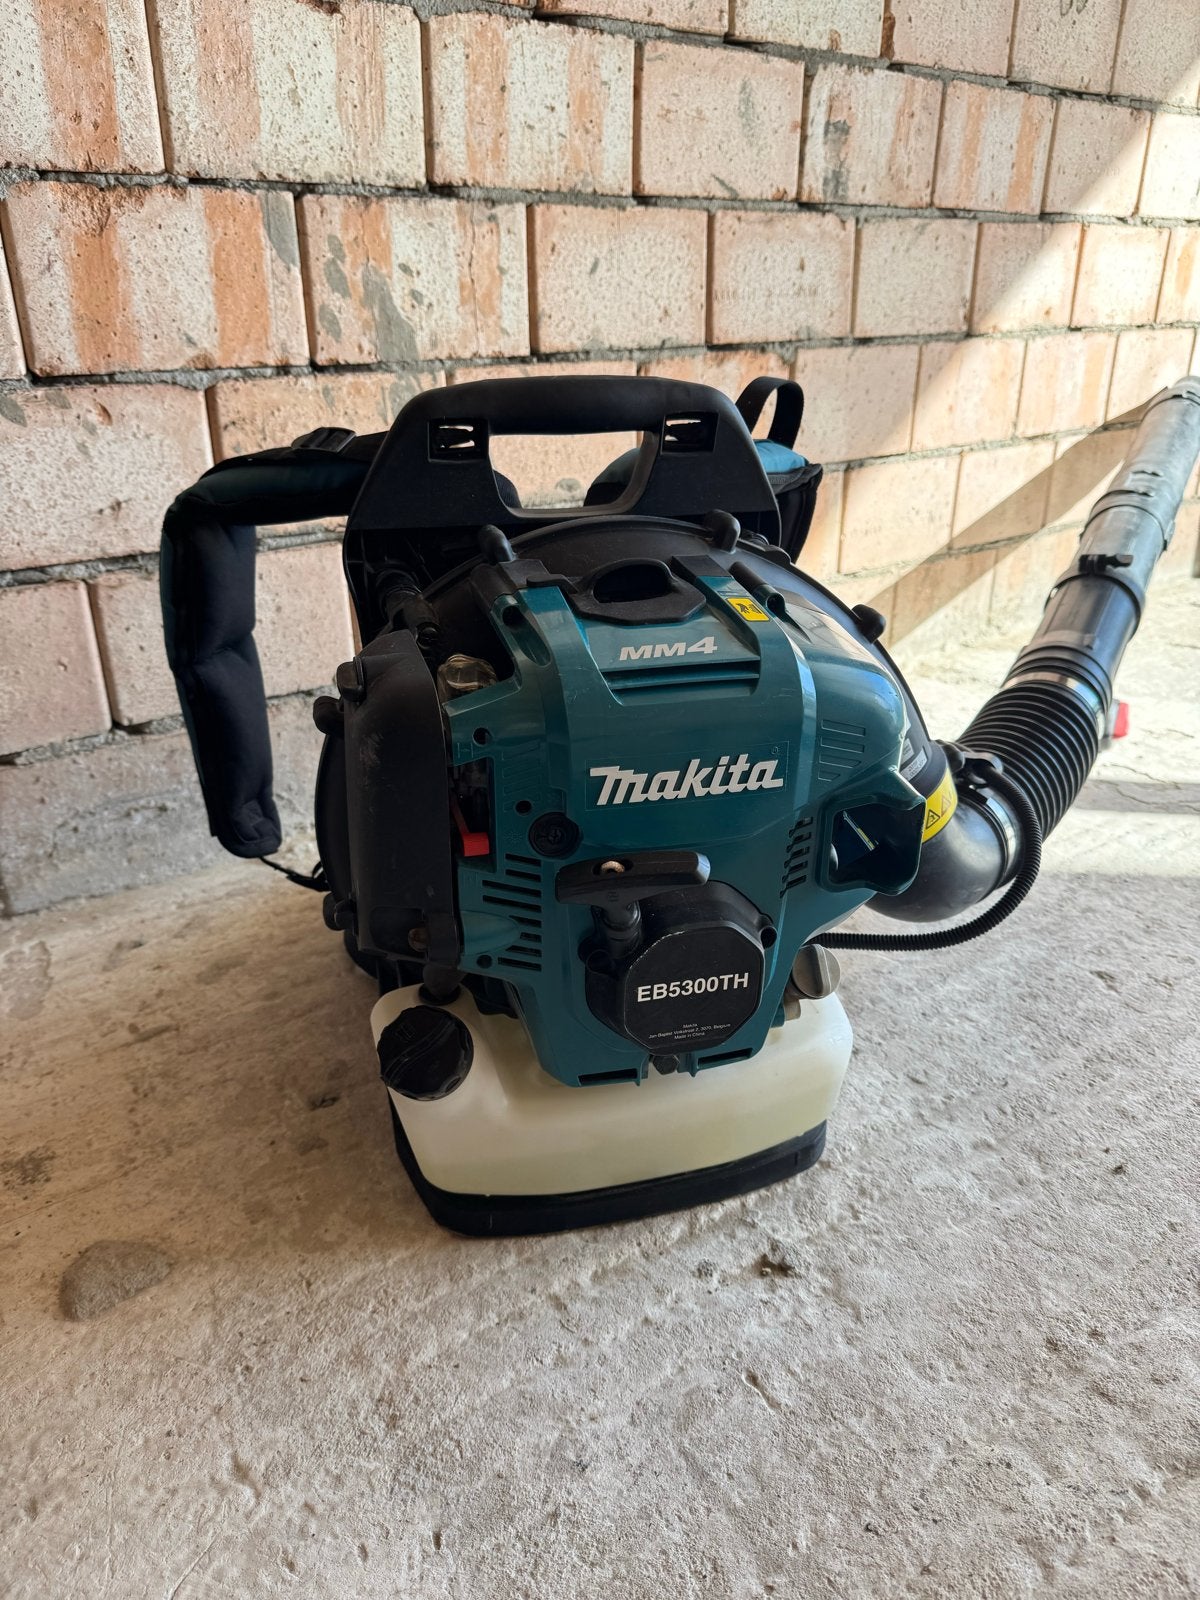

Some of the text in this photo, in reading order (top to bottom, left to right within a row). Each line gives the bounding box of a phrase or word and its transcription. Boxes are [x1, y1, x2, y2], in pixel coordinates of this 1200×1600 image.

[619, 637, 717, 661] MM4
[590, 753, 784, 806] Makita
[637, 972, 749, 1003] EB5300TH
